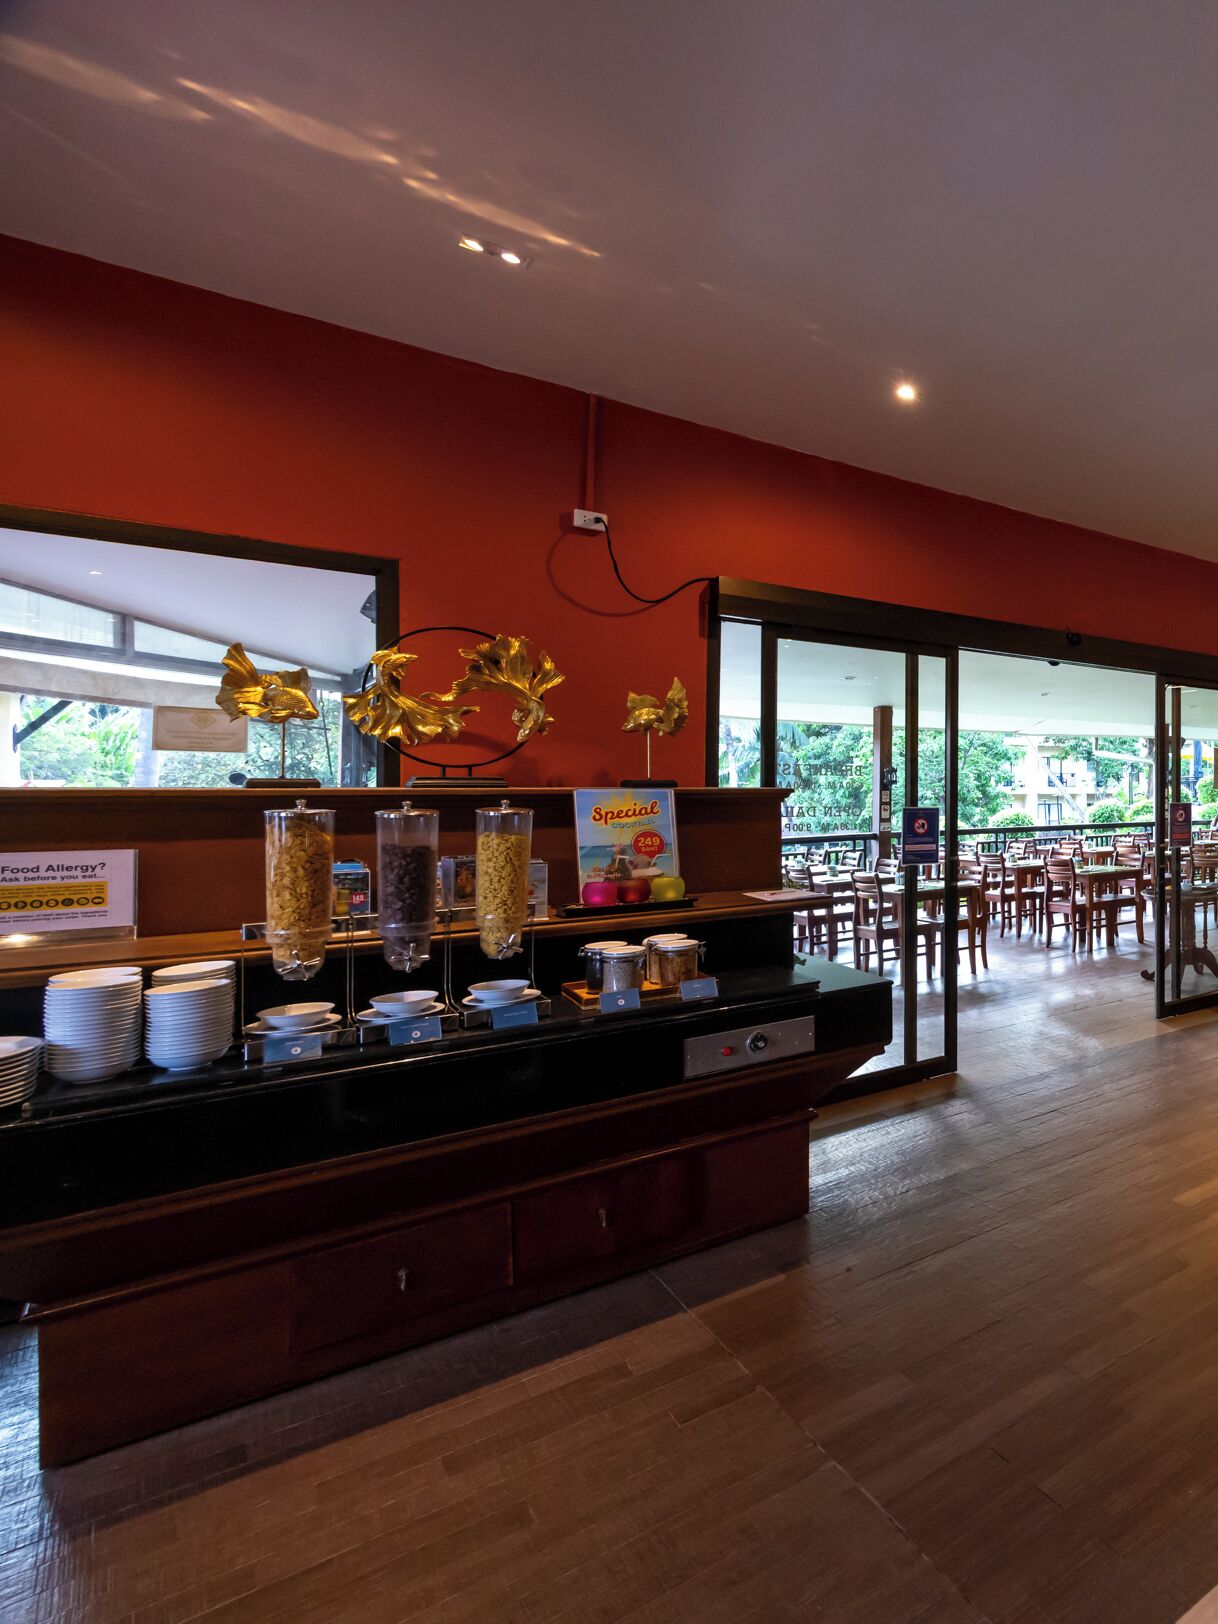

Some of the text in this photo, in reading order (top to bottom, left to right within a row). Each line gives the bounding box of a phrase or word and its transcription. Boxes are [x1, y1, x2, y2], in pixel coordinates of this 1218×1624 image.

[592, 800, 660, 825] Special
[638, 836, 660, 846] 249
[0, 862, 106, 875] Food Allergy?
